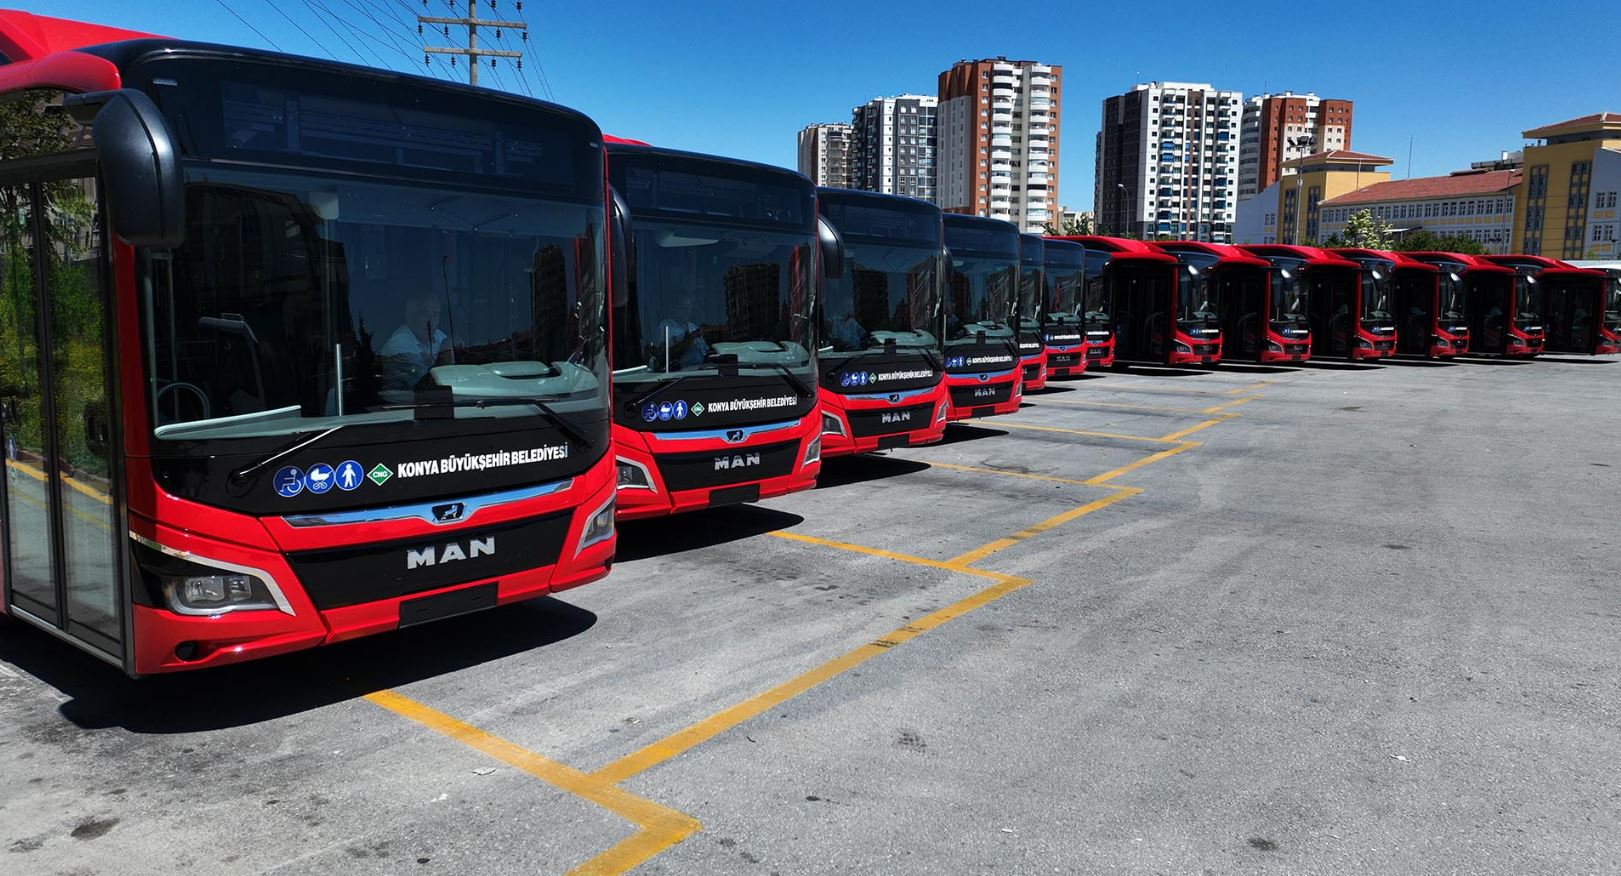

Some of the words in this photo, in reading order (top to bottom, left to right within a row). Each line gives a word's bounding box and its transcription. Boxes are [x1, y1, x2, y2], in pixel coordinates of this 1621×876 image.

[974, 388, 995, 397] MAN
[708, 402, 729, 413] KONYA
[730, 397, 766, 411] BÜYÜKŞEHİR
[767, 394, 797, 408] BELEDİYESİ
[881, 410, 910, 423] MAN
[398, 460, 439, 478] KONYA
[441, 449, 511, 472] BÜYÜKŞEHİR
[511, 442, 568, 465] BELEDİYESİ
[714, 452, 760, 471] MAN
[407, 536, 496, 569] MAN
